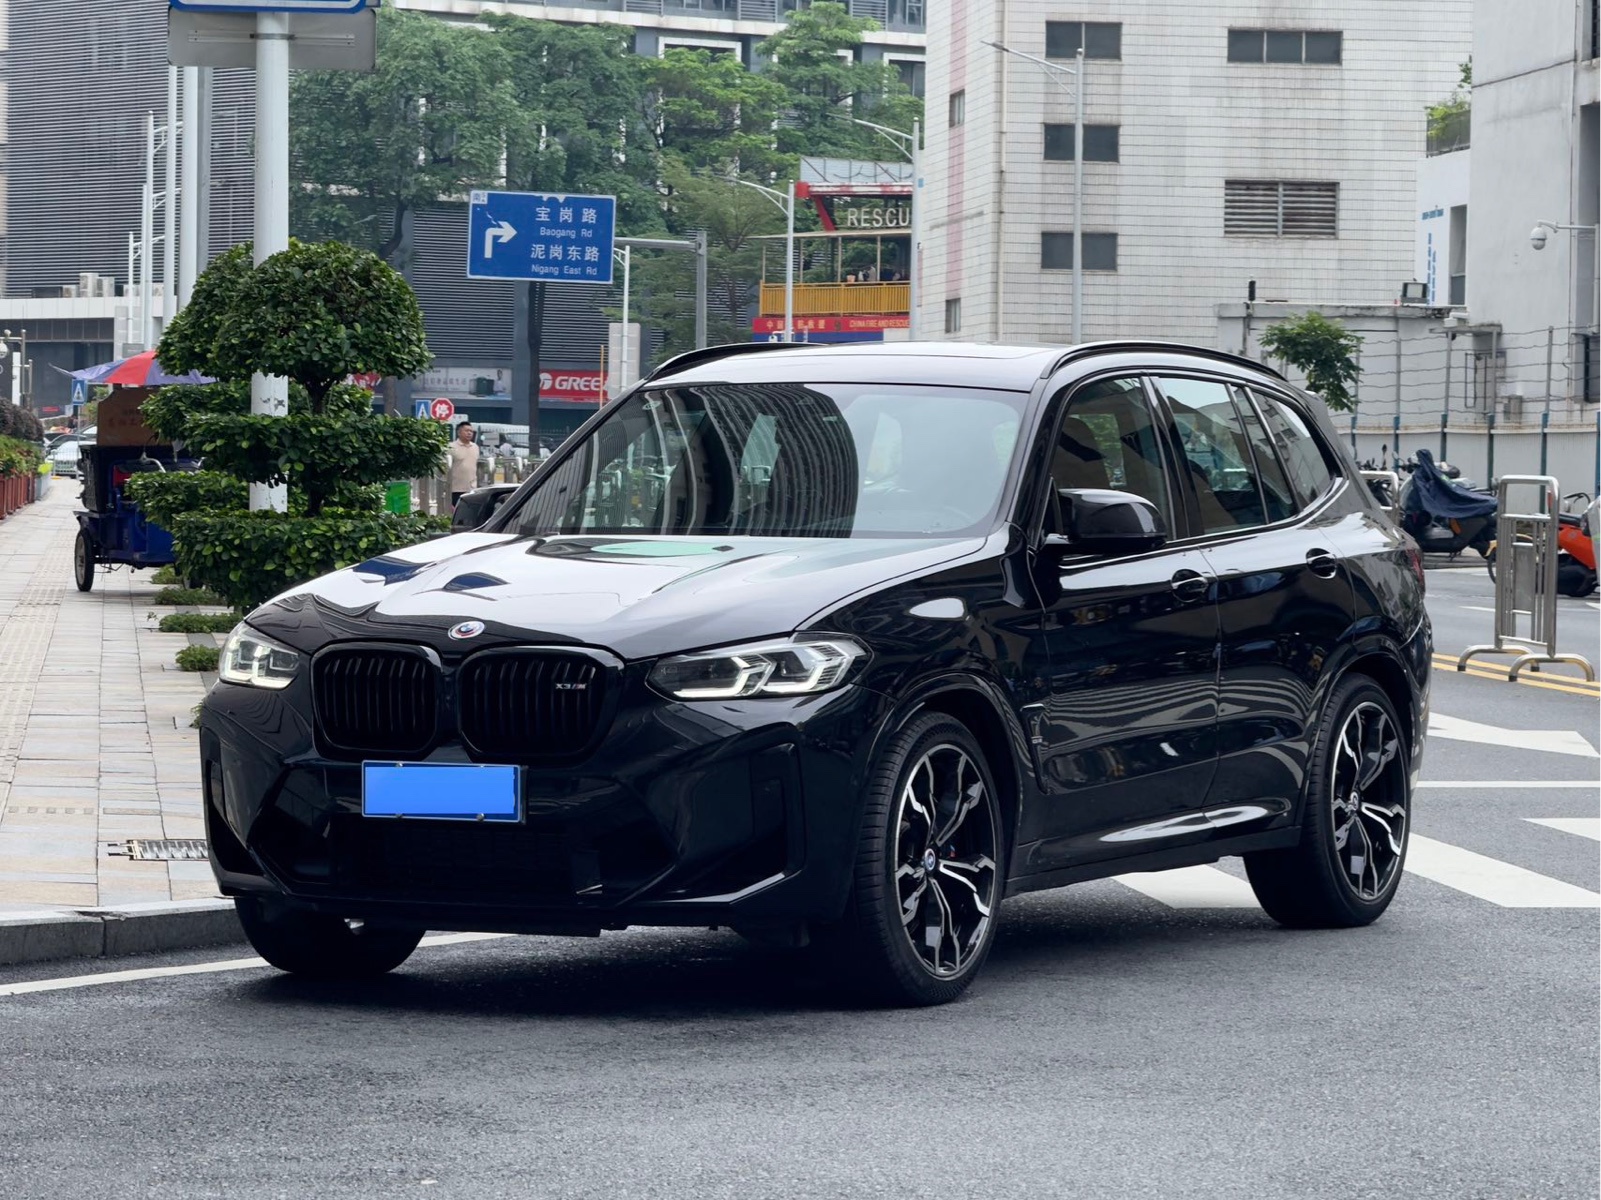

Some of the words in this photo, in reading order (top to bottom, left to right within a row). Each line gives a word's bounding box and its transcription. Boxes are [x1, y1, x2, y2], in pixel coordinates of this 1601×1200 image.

[535, 206, 597, 224] 宝岗路
[540, 227, 576, 239] Baogang
[581, 228, 593, 238] Rd
[530, 244, 600, 262] 泥岗东路
[531, 264, 559, 275] Nigang
[563, 265, 581, 275] East
[586, 266, 597, 275] Rd
[554, 375, 601, 391] GREE
[434, 403, 450, 419] 停
